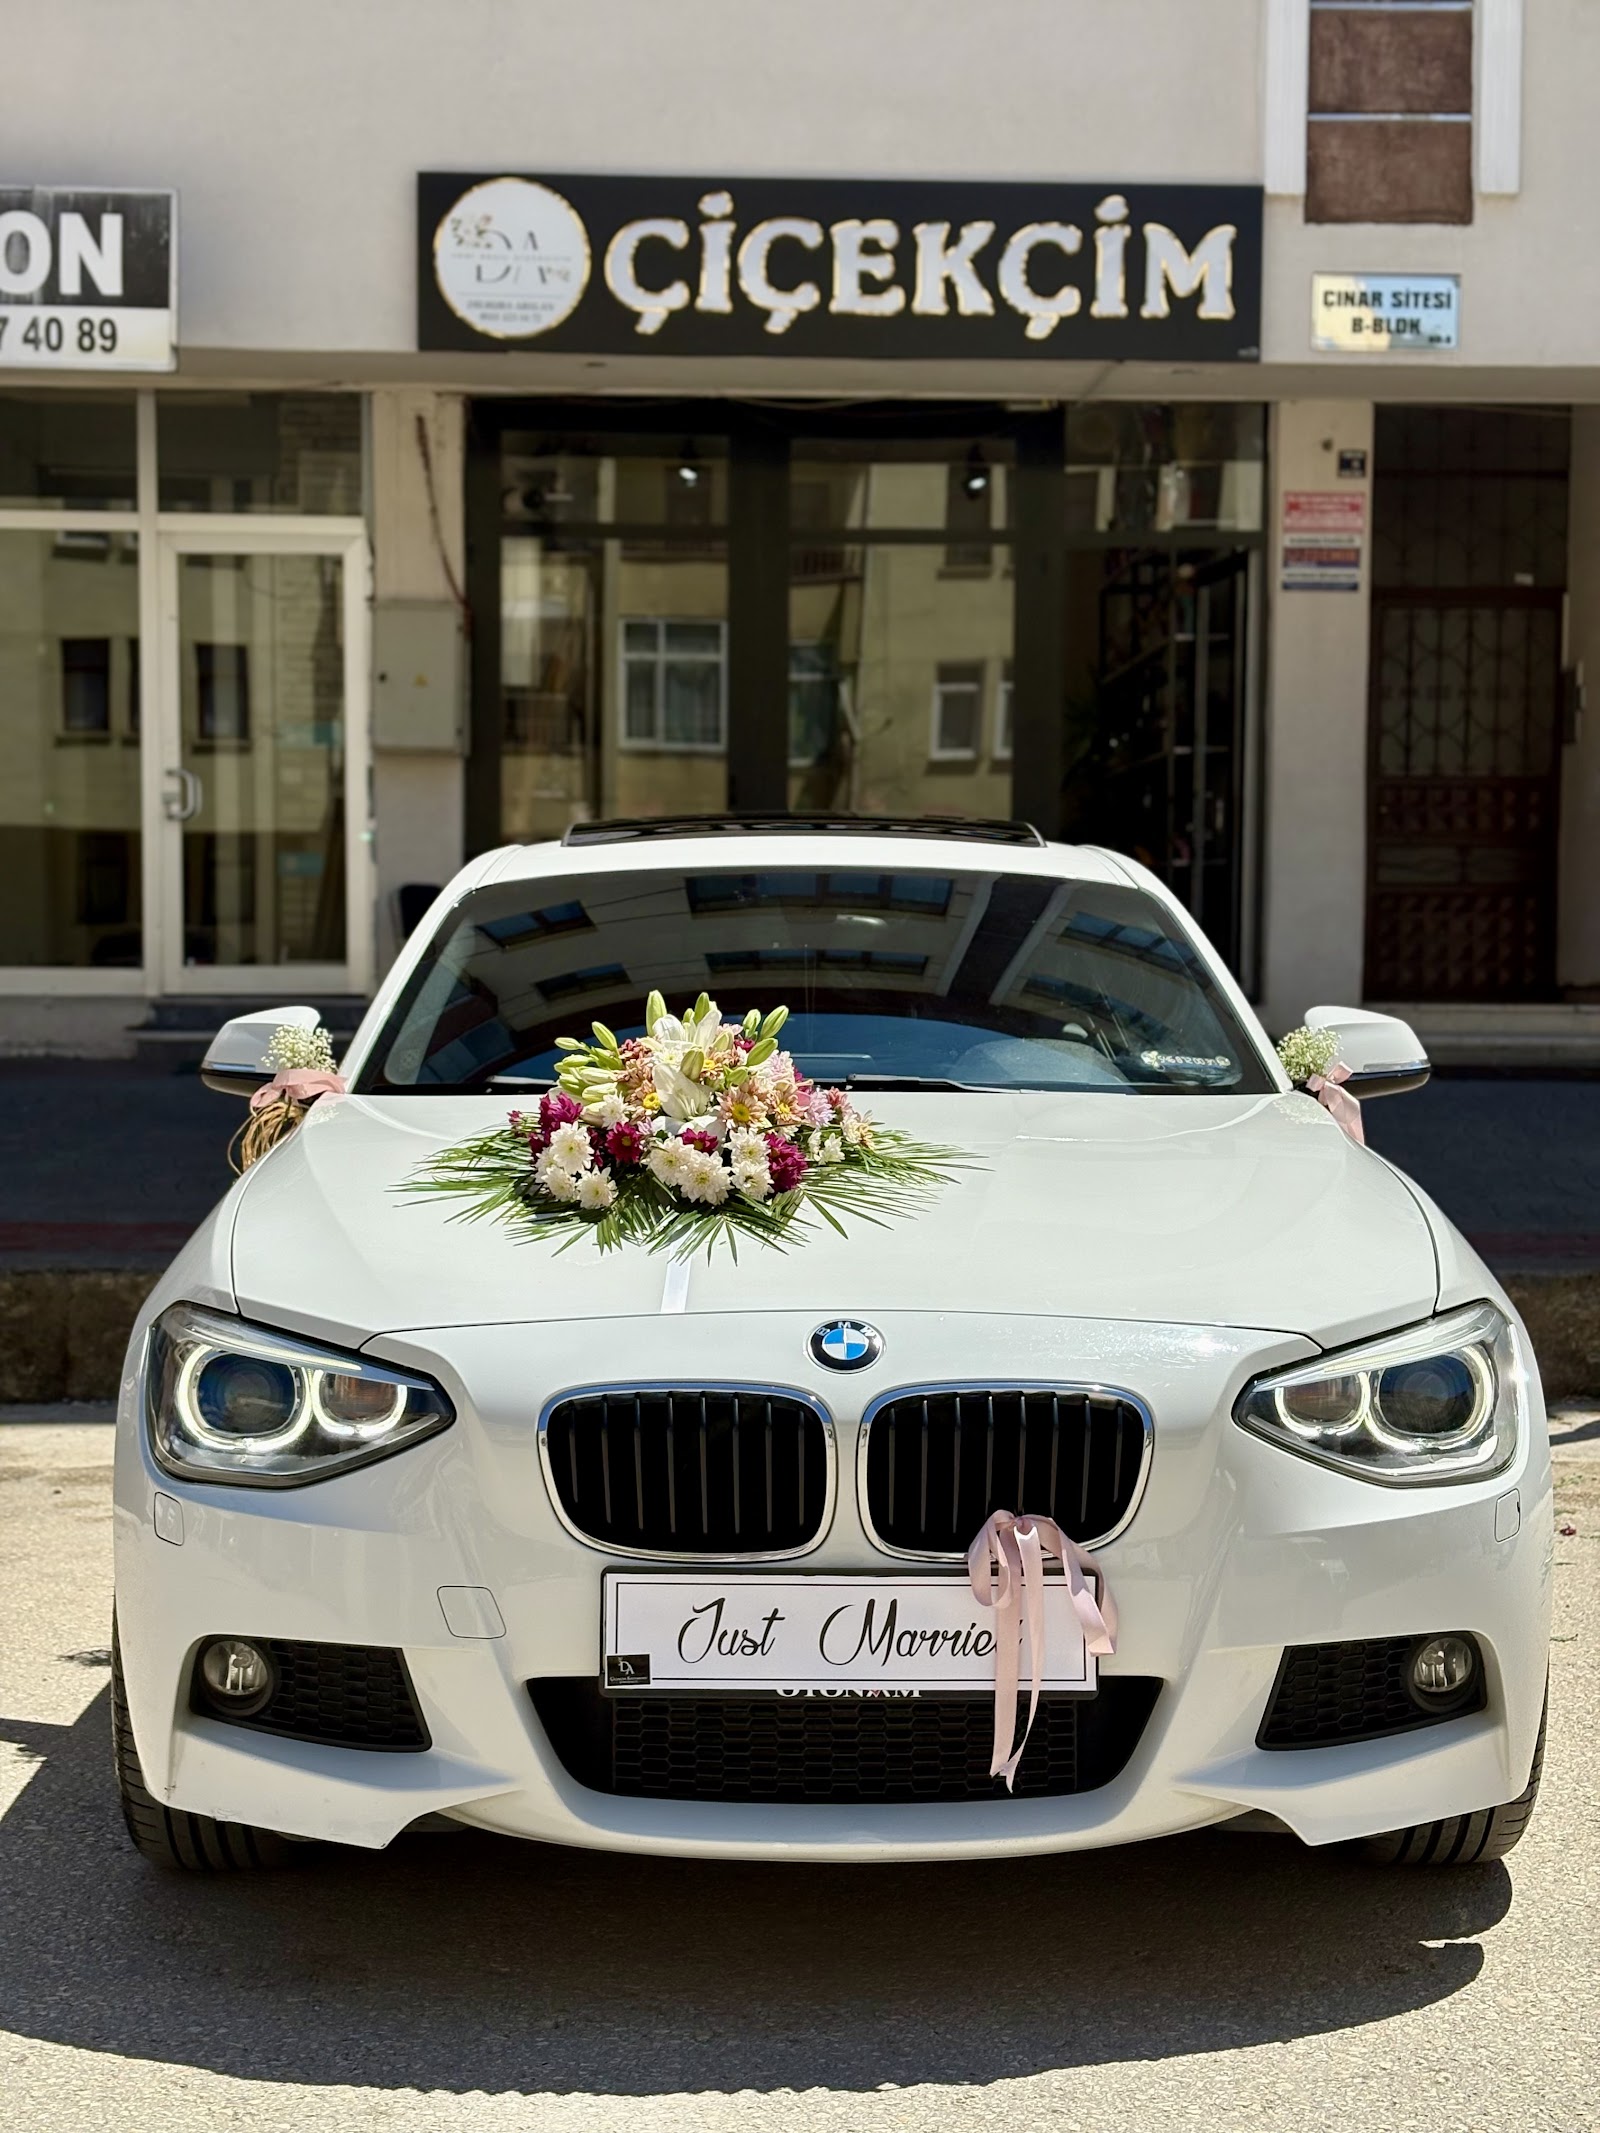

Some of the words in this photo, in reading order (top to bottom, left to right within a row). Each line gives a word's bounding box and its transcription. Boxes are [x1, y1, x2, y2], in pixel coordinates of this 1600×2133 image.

[0, 209, 123, 296] ON
[603, 190, 1237, 339] ÇİÇEKÇİM
[1391, 286, 1452, 310] SİTESİ
[22, 316, 64, 352] 40
[77, 317, 118, 353] 89
[816, 1321, 877, 1338] BMW
[677, 1597, 786, 1665] Just
[818, 1598, 1024, 1667] Marrie
